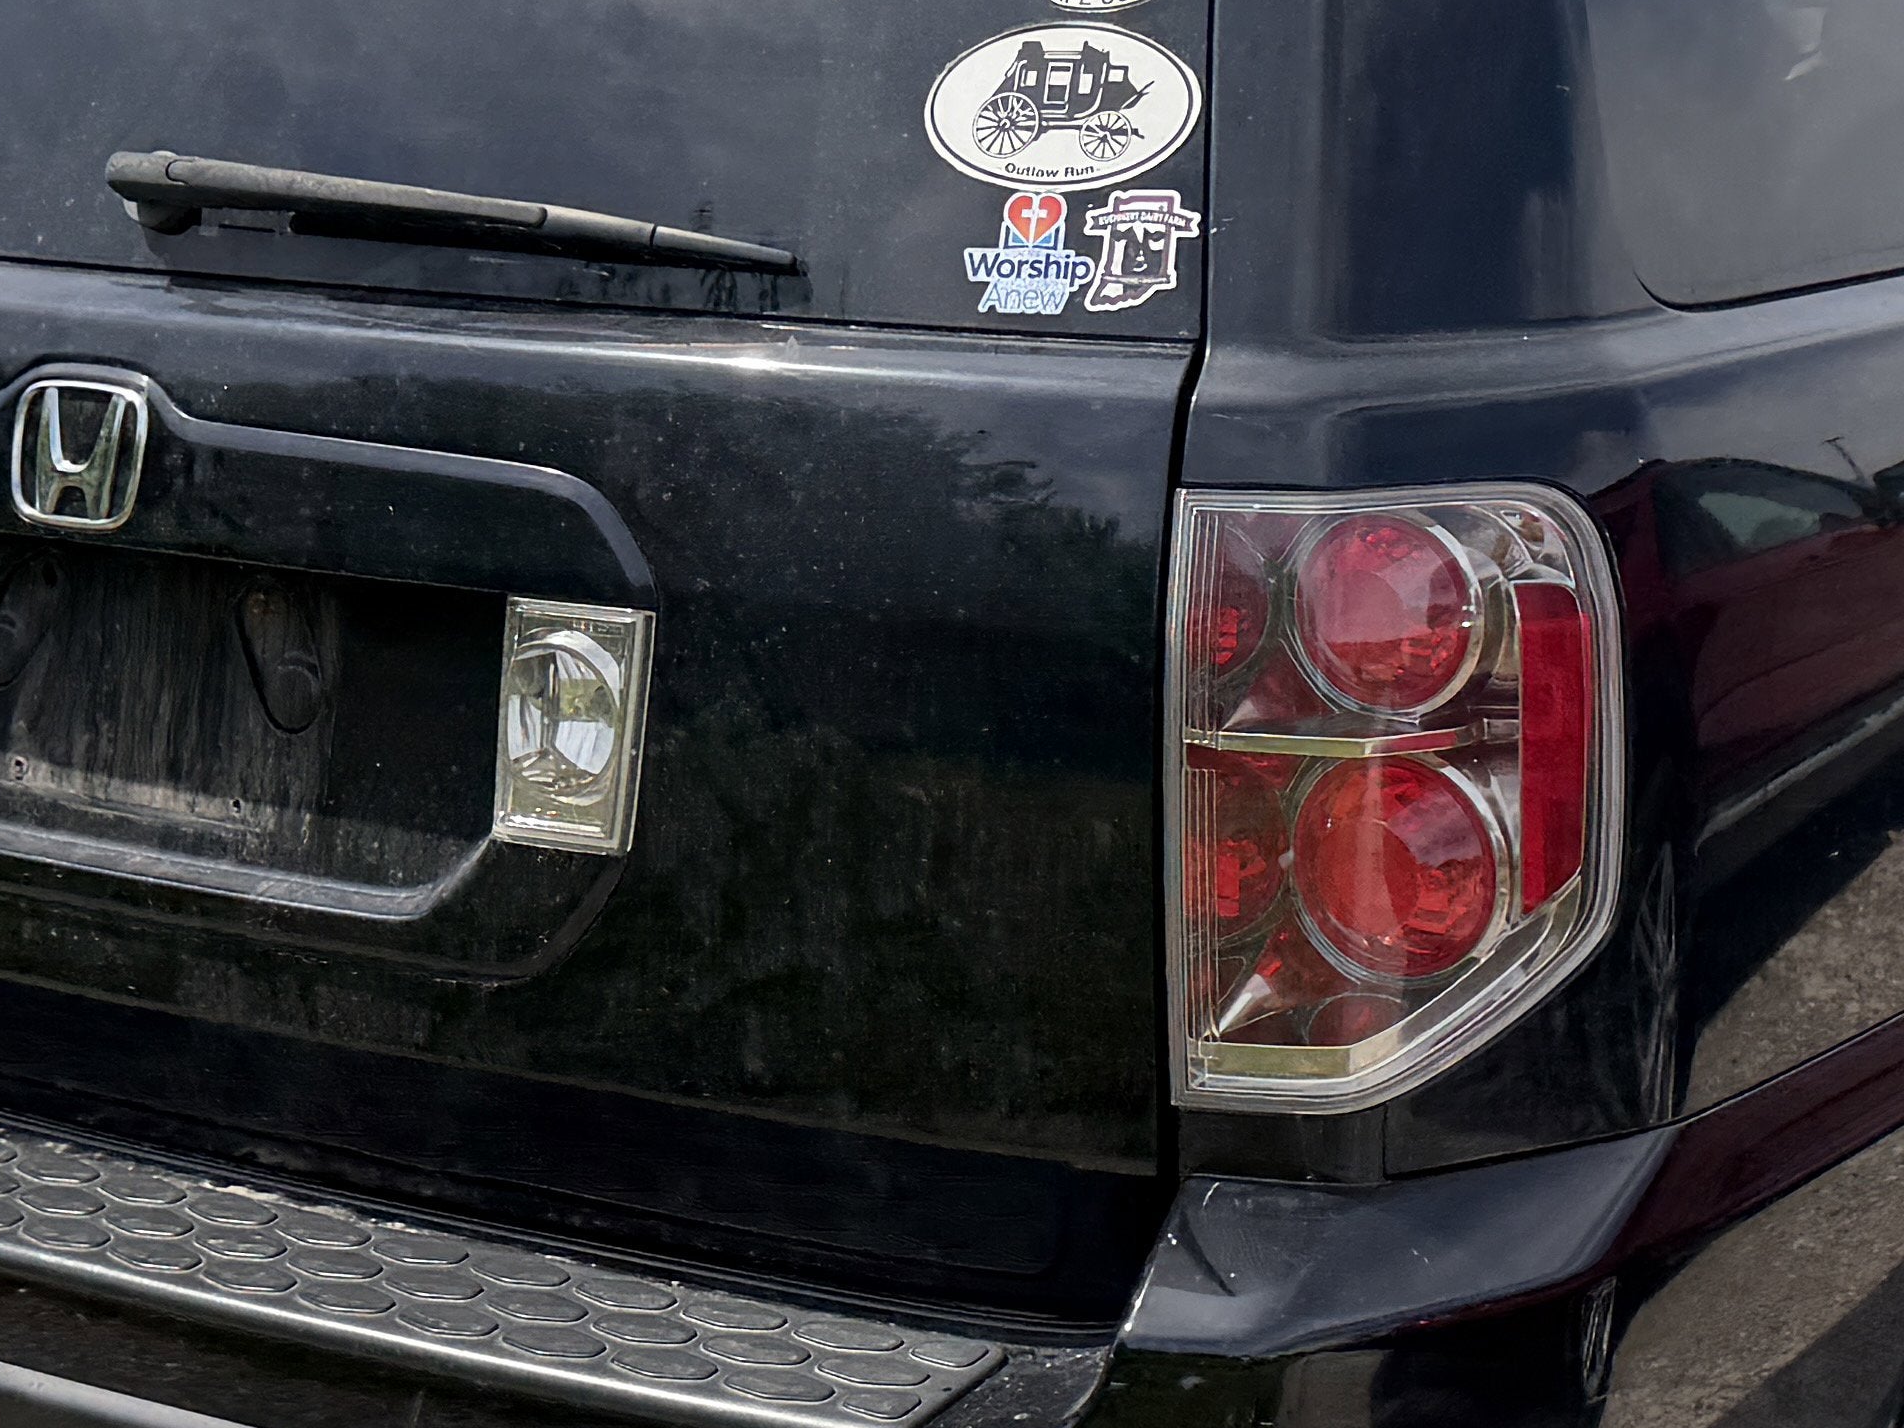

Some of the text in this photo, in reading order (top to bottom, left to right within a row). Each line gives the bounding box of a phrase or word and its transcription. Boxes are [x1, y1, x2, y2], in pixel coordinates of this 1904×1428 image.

[1005, 163, 1095, 178] Outlaw Run
[968, 253, 1091, 288] Worship
[982, 281, 1067, 310] Anew
